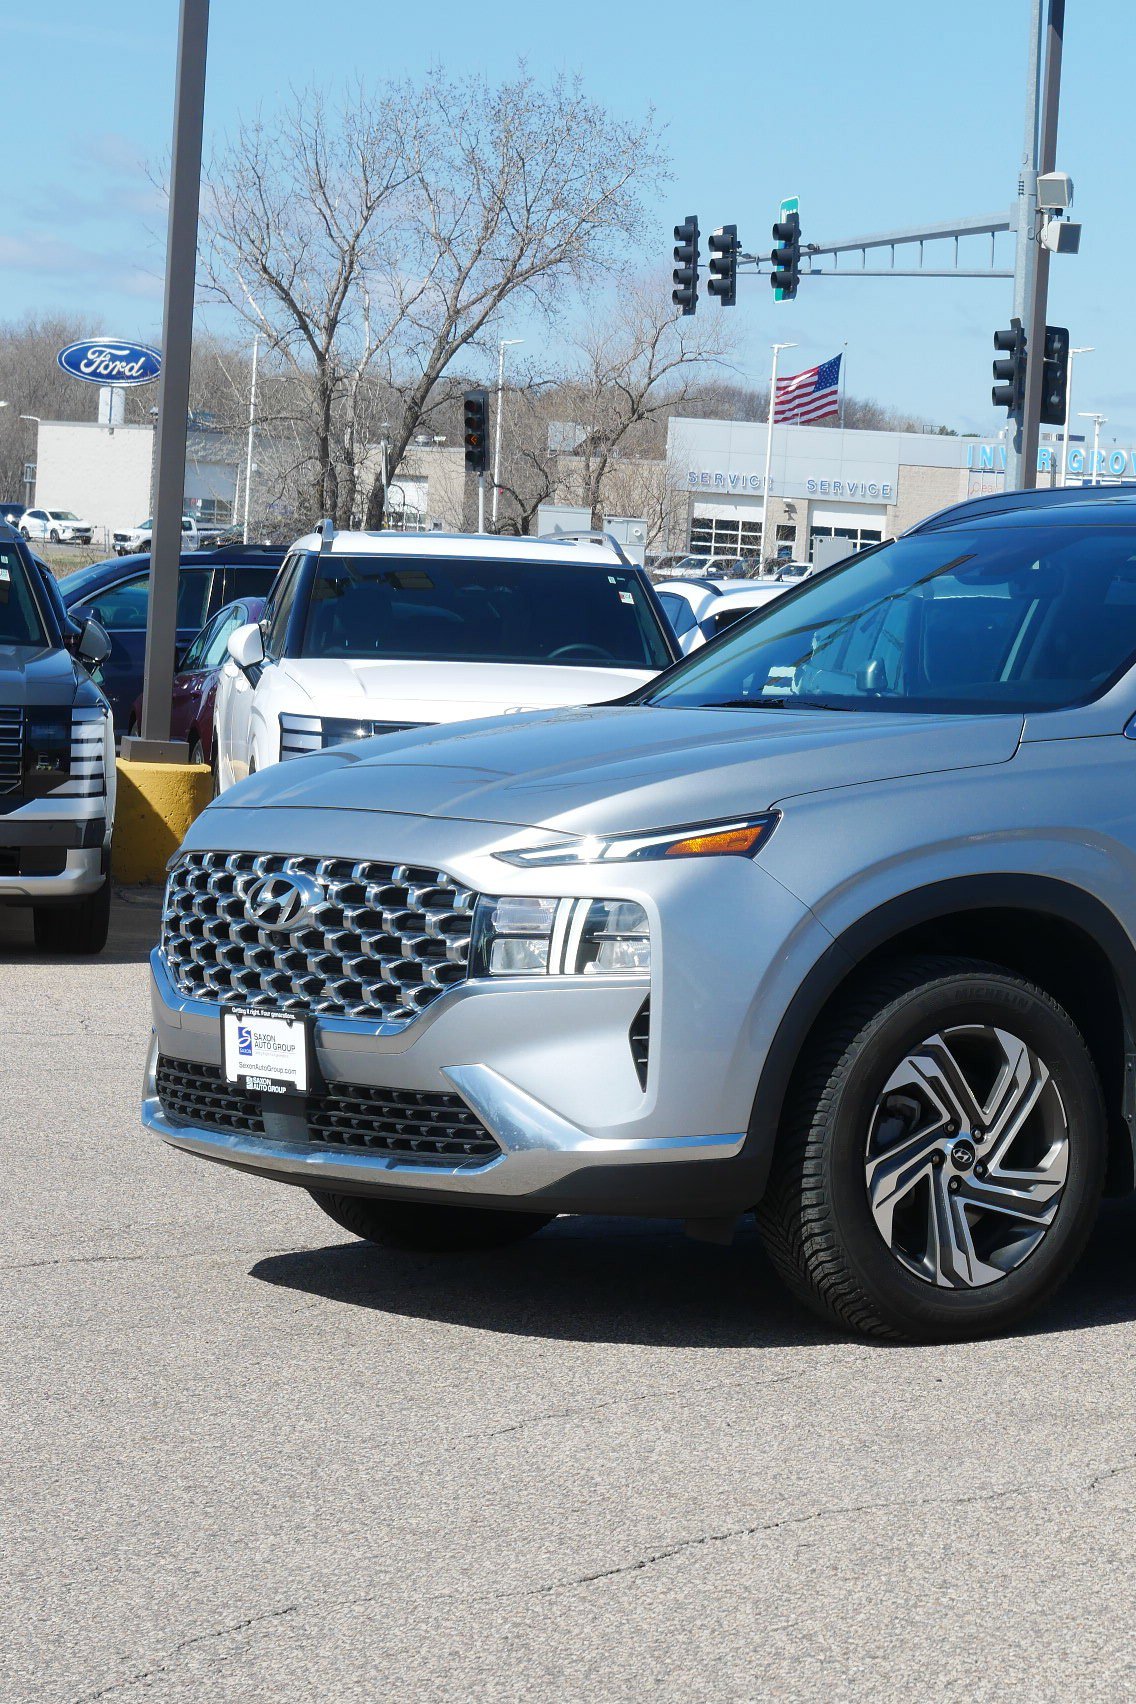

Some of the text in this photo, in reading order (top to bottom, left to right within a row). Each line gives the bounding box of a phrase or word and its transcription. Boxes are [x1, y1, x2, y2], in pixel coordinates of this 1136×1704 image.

[80, 347, 146, 377] Ford
[807, 479, 892, 497] SERVICE
[253, 1032, 276, 1043] SAXON
[254, 1041, 296, 1053] AUTO GROUP
[252, 1076, 272, 1086] SAXON
[253, 1082, 287, 1094] AUTO GROUP
